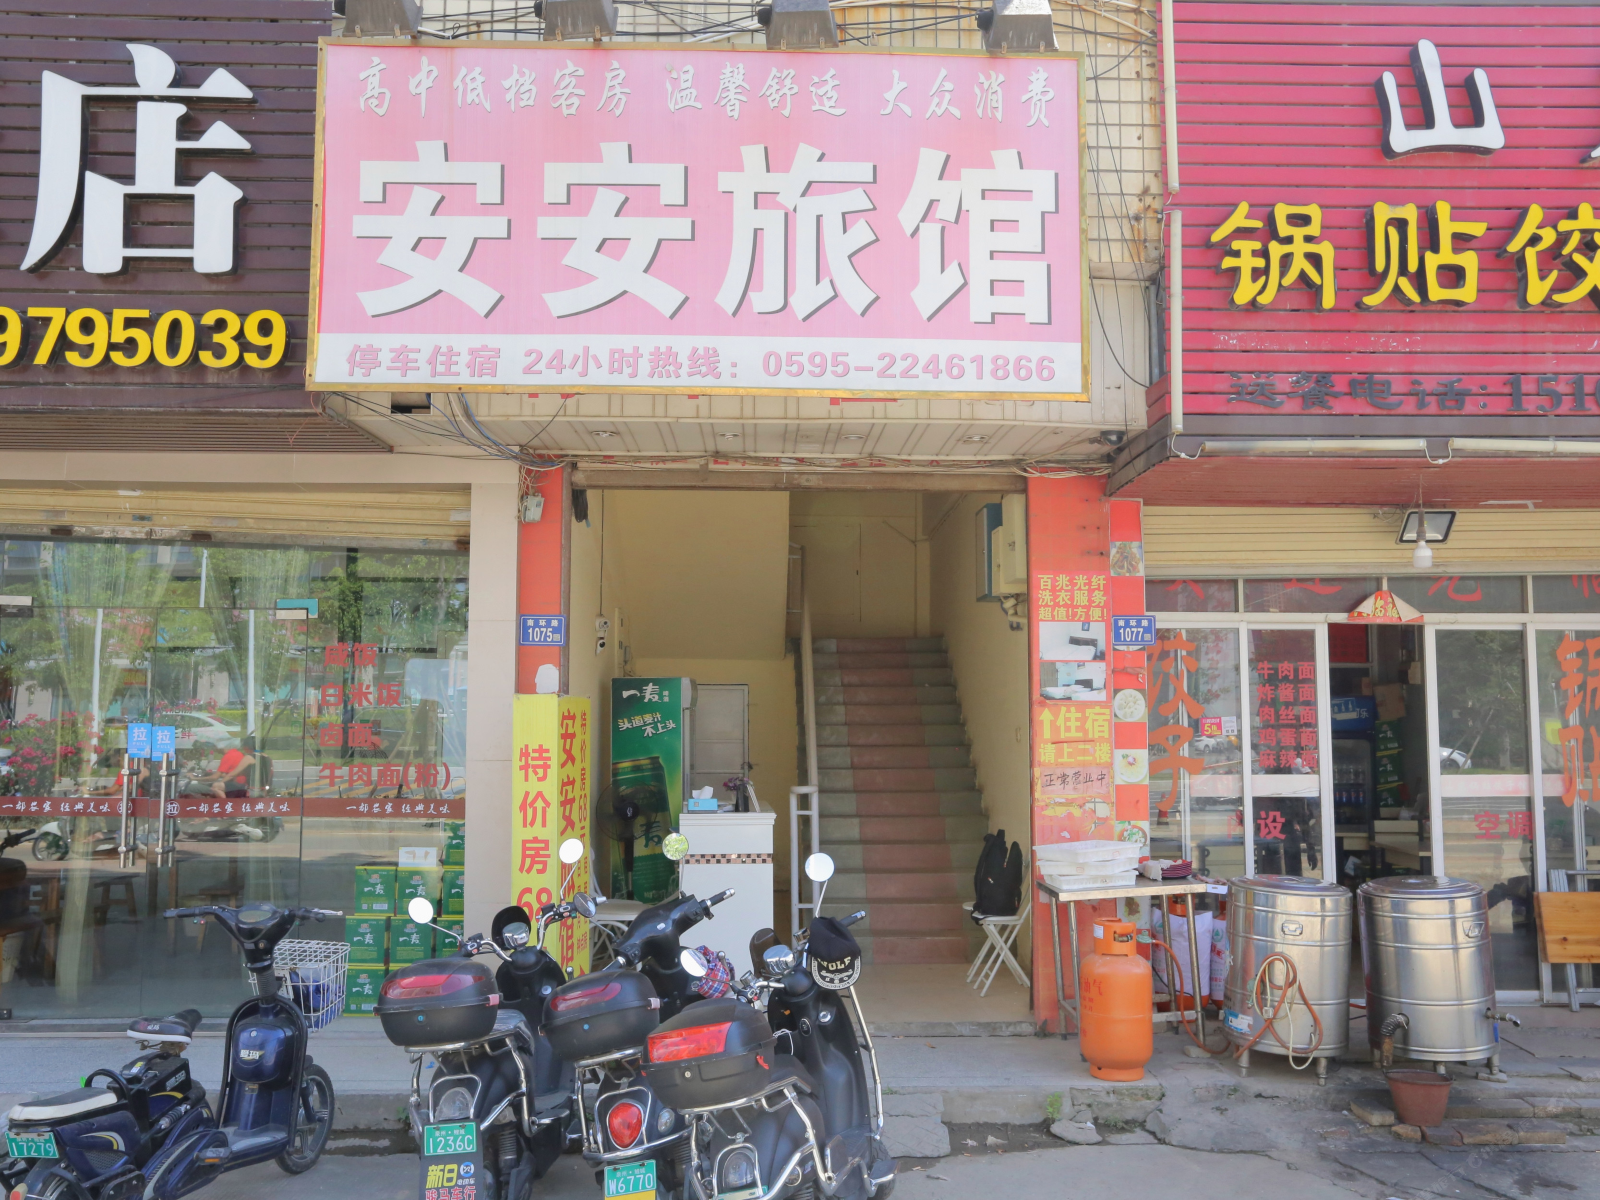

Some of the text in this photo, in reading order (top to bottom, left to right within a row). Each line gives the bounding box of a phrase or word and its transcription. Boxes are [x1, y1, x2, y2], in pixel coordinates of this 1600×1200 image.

[359, 55, 1056, 128] 高中低档客房 温馨舒适 大众消费
[1380, 38, 1506, 154] 山
[20, 44, 254, 274] 店
[352, 140, 1060, 325] 安安旅馆
[346, 344, 502, 378] 停车住宿
[762, 350, 1056, 382] 0595-22461866
[1038, 574, 1107, 590] 百兆光纤
[1038, 590, 1107, 606] 洗衣服务
[1118, 619, 1149, 627] 南环路
[528, 627, 553, 642] 1075
[1119, 628, 1144, 642] 1077
[324, 642, 378, 667] 咸饭
[1257, 661, 1316, 680] 牛肉面
[320, 682, 402, 707] 白米饭
[1257, 684, 1316, 702] 炸酱面
[1056, 706, 1111, 738] 住宿
[1258, 706, 1317, 724] 肉丝面
[133, 727, 147, 741] 拉
[156, 730, 171, 744] 拉
[320, 722, 373, 747] 卤面
[1258, 728, 1317, 747] 鸡蛋面
[1039, 743, 1111, 763] 请上二楼
[1259, 750, 1318, 768] 麻辣面
[319, 762, 450, 791] 牛肉面(粉)
[1042, 770, 1107, 791] 正常营业中
[1474, 810, 1533, 839] 空调
[429, 1135, 473, 1154] 1236C
[426, 1164, 458, 1189] 新日
[609, 1173, 654, 1195] W6770
